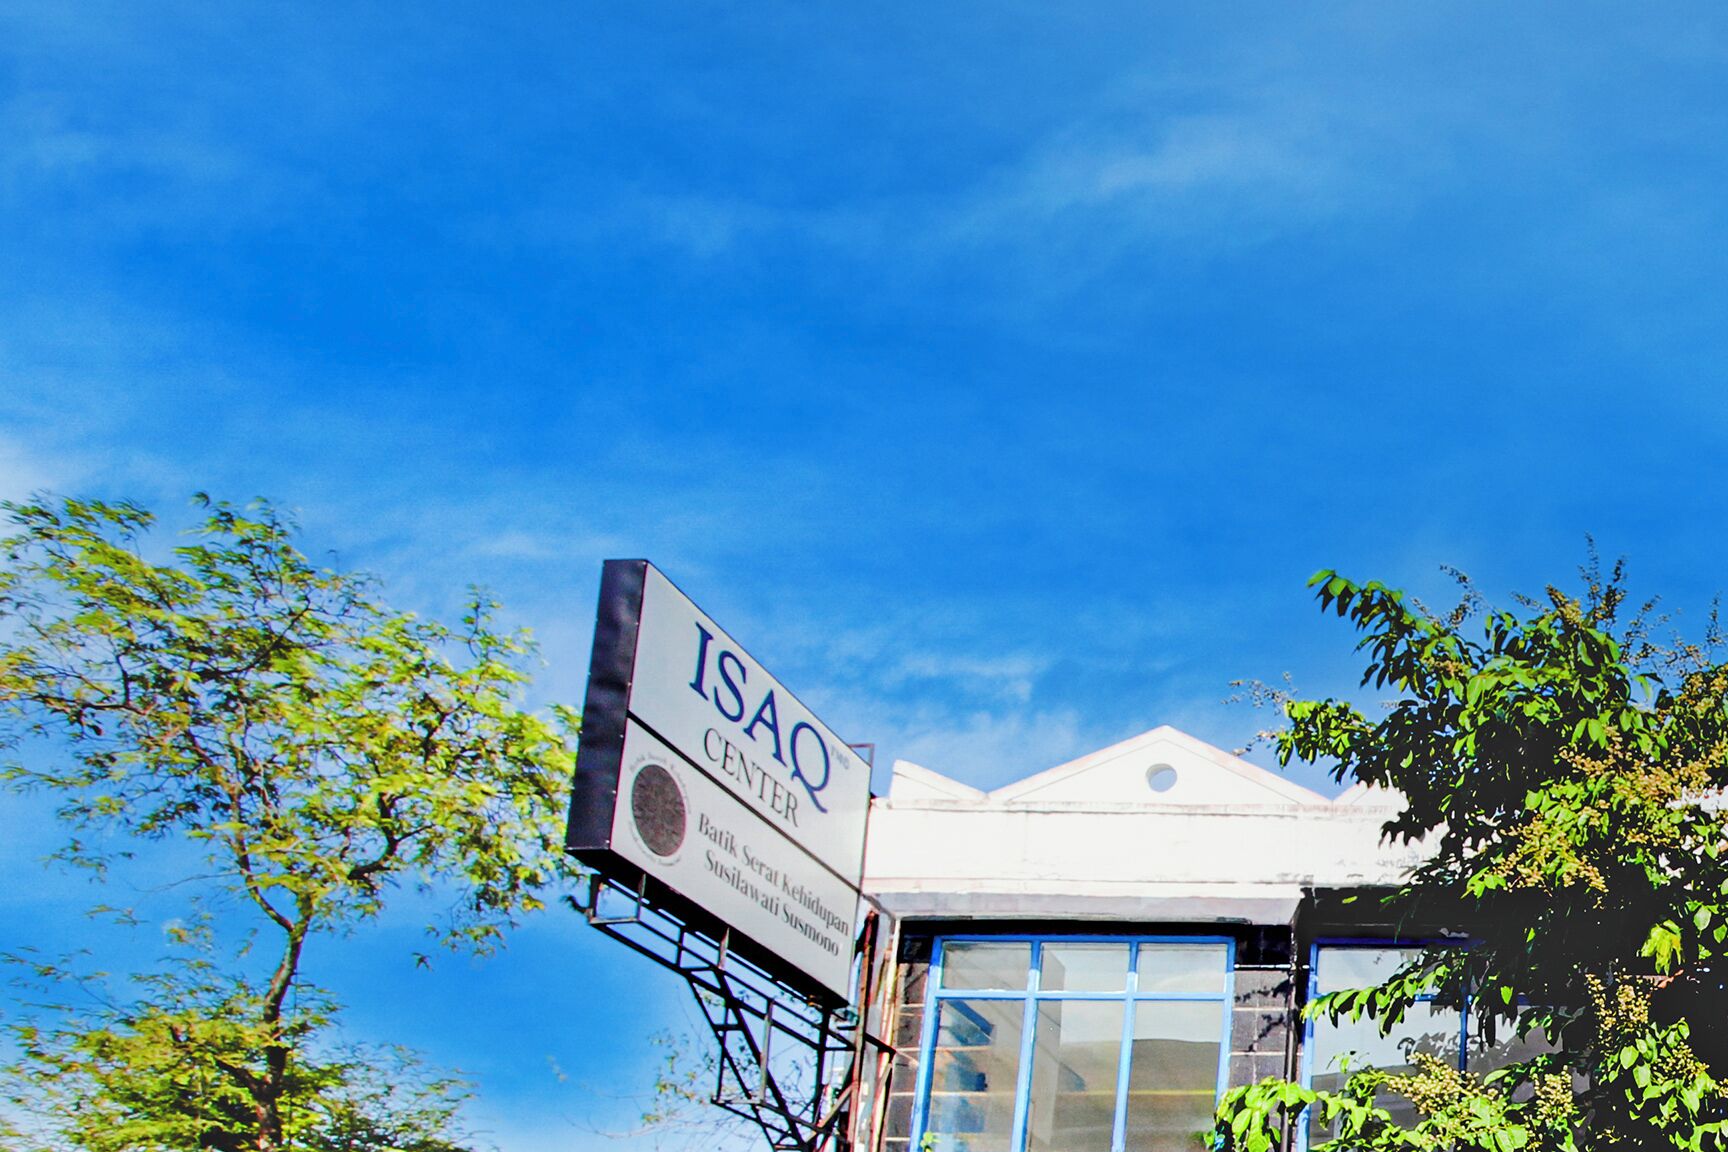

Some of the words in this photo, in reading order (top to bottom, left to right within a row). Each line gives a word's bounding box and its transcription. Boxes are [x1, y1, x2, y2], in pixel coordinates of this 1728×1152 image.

[689, 621, 829, 815] ISAQ
[704, 727, 799, 828] CENTER
[698, 812, 737, 859] Batik
[742, 845, 779, 887] Serat
[782, 873, 850, 937] Kehidupan
[704, 849, 780, 917] Susilawati
[781, 903, 840, 957] Susmono
